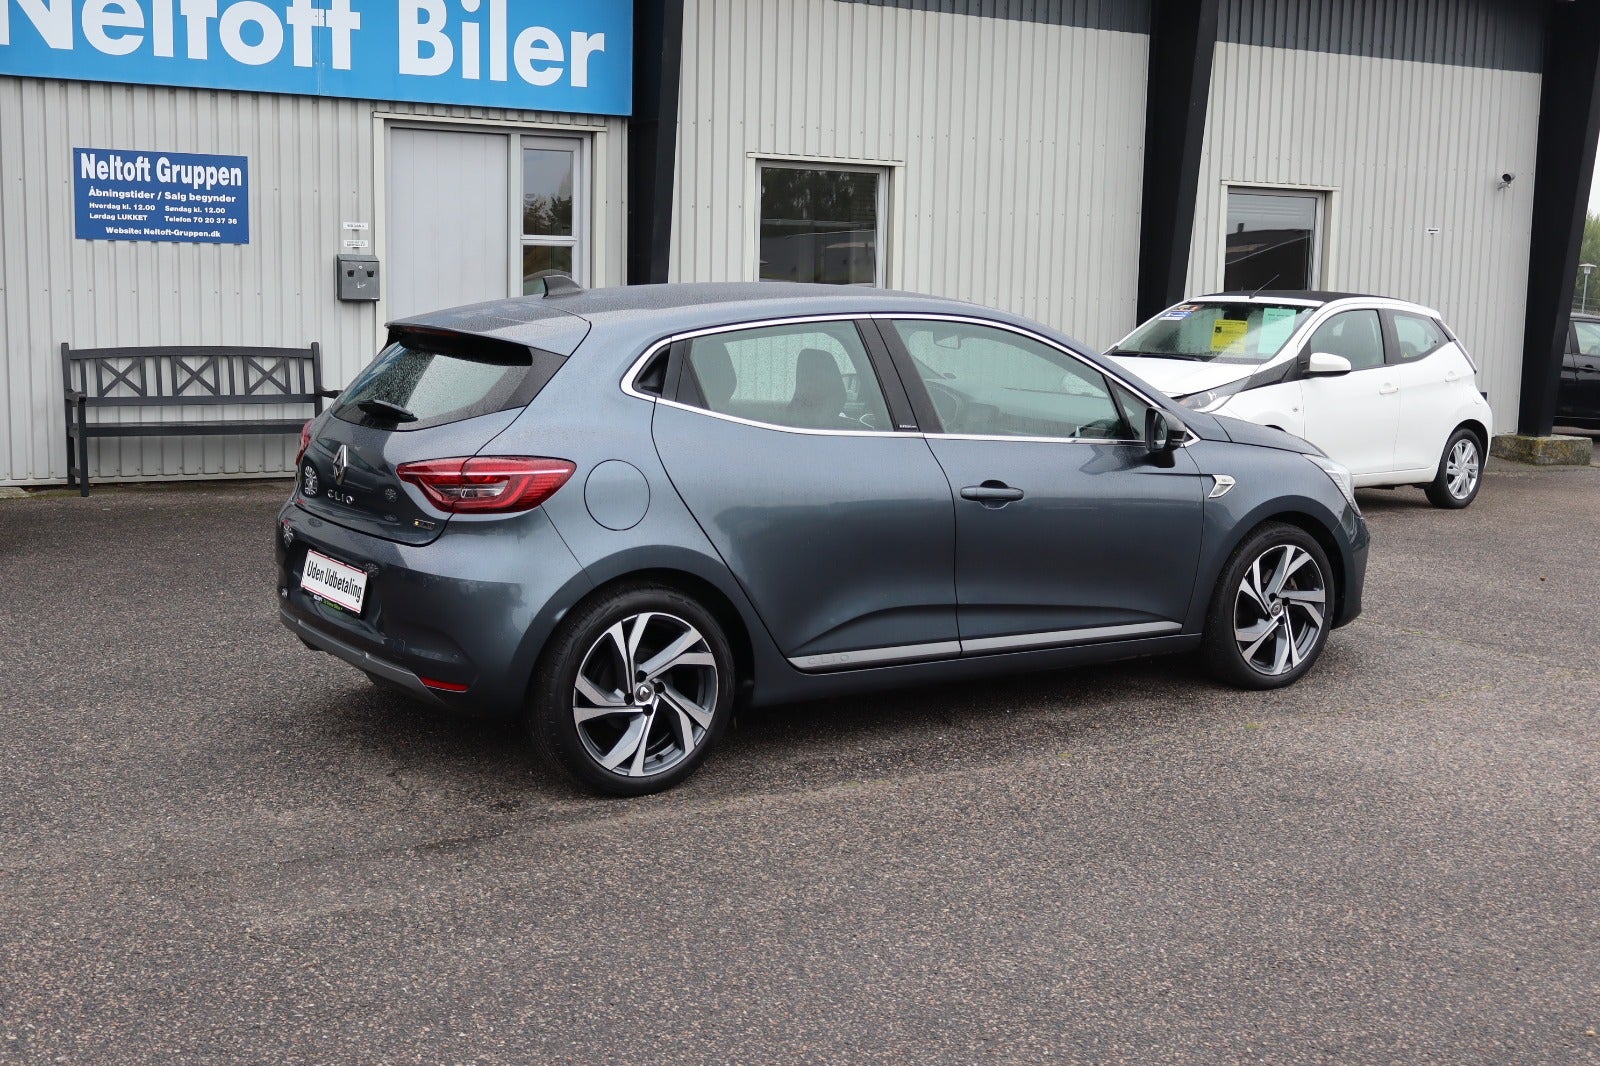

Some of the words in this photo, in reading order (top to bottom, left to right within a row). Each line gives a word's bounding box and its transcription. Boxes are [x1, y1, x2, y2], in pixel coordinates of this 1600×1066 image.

[399, 0, 605, 87] Biler
[81, 153, 151, 182] Neltoft
[156, 156, 242, 190] Gruppen
[88, 185, 155, 200] Åbningstider
[164, 191, 187, 202] Salg
[189, 193, 236, 203] begynder
[89, 202, 121, 211] Hverdag
[164, 205, 192, 213] Søndag
[89, 212, 116, 220] Lørdag
[117, 213, 148, 221] LUKKET
[164, 215, 192, 223] Telefon
[105, 226, 142, 235] Website:
[143, 228, 221, 238] Neltoft-Gruppen.dk
[328, 490, 354, 504] CLIO
[306, 560, 325, 583] Uden
[325, 568, 362, 603] Udbetaling
[807, 654, 849, 665] CLIO
